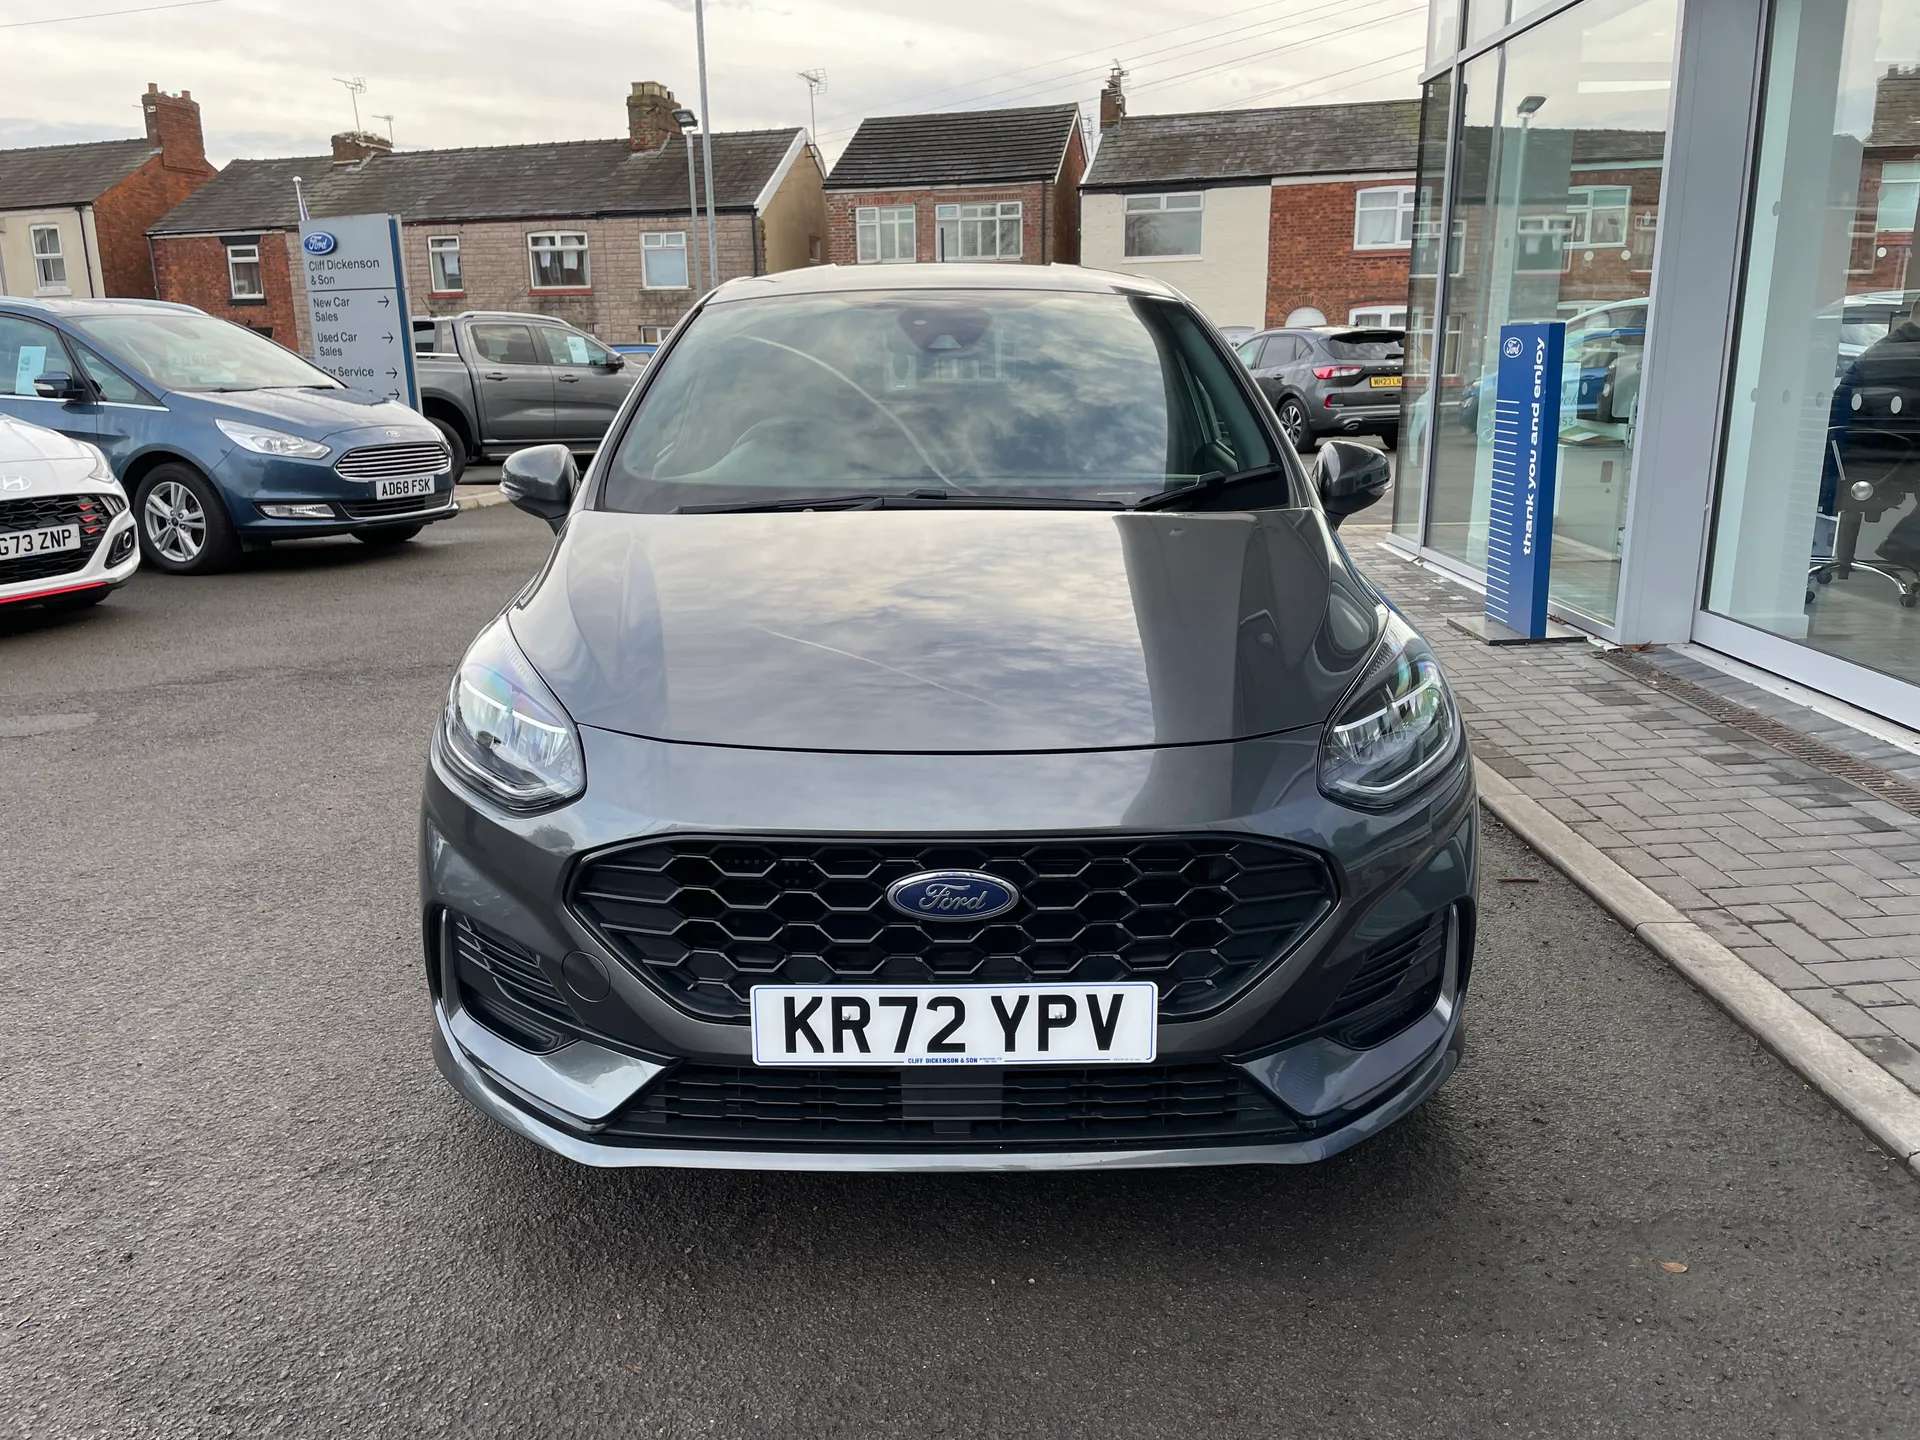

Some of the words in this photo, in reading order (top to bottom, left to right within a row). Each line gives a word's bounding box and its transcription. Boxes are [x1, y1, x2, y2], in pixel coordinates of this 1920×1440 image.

[308, 235, 328, 250] Ford
[309, 260, 325, 271] Cliff
[327, 258, 380, 270] Dickenson
[311, 275, 317, 285] &
[318, 274, 335, 285] Son
[313, 298, 331, 308] New
[333, 296, 350, 307] Car
[315, 311, 339, 321] Sales
[318, 331, 339, 342] Used
[340, 331, 357, 342] Car
[320, 346, 342, 356] Sales
[1507, 340, 1520, 354] Ford
[338, 366, 374, 377] Service
[1533, 337, 1545, 398] enjoy
[1531, 403, 1540, 446] and
[1528, 449, 1537, 489] you
[381, 480, 410, 496] AD68
[411, 478, 431, 493] FSK
[1523, 493, 1535, 555] thank
[38, 528, 71, 550] ZNP
[919, 883, 988, 910] Ford
[784, 995, 966, 1054] KR72
[991, 993, 1125, 1053] YPV
